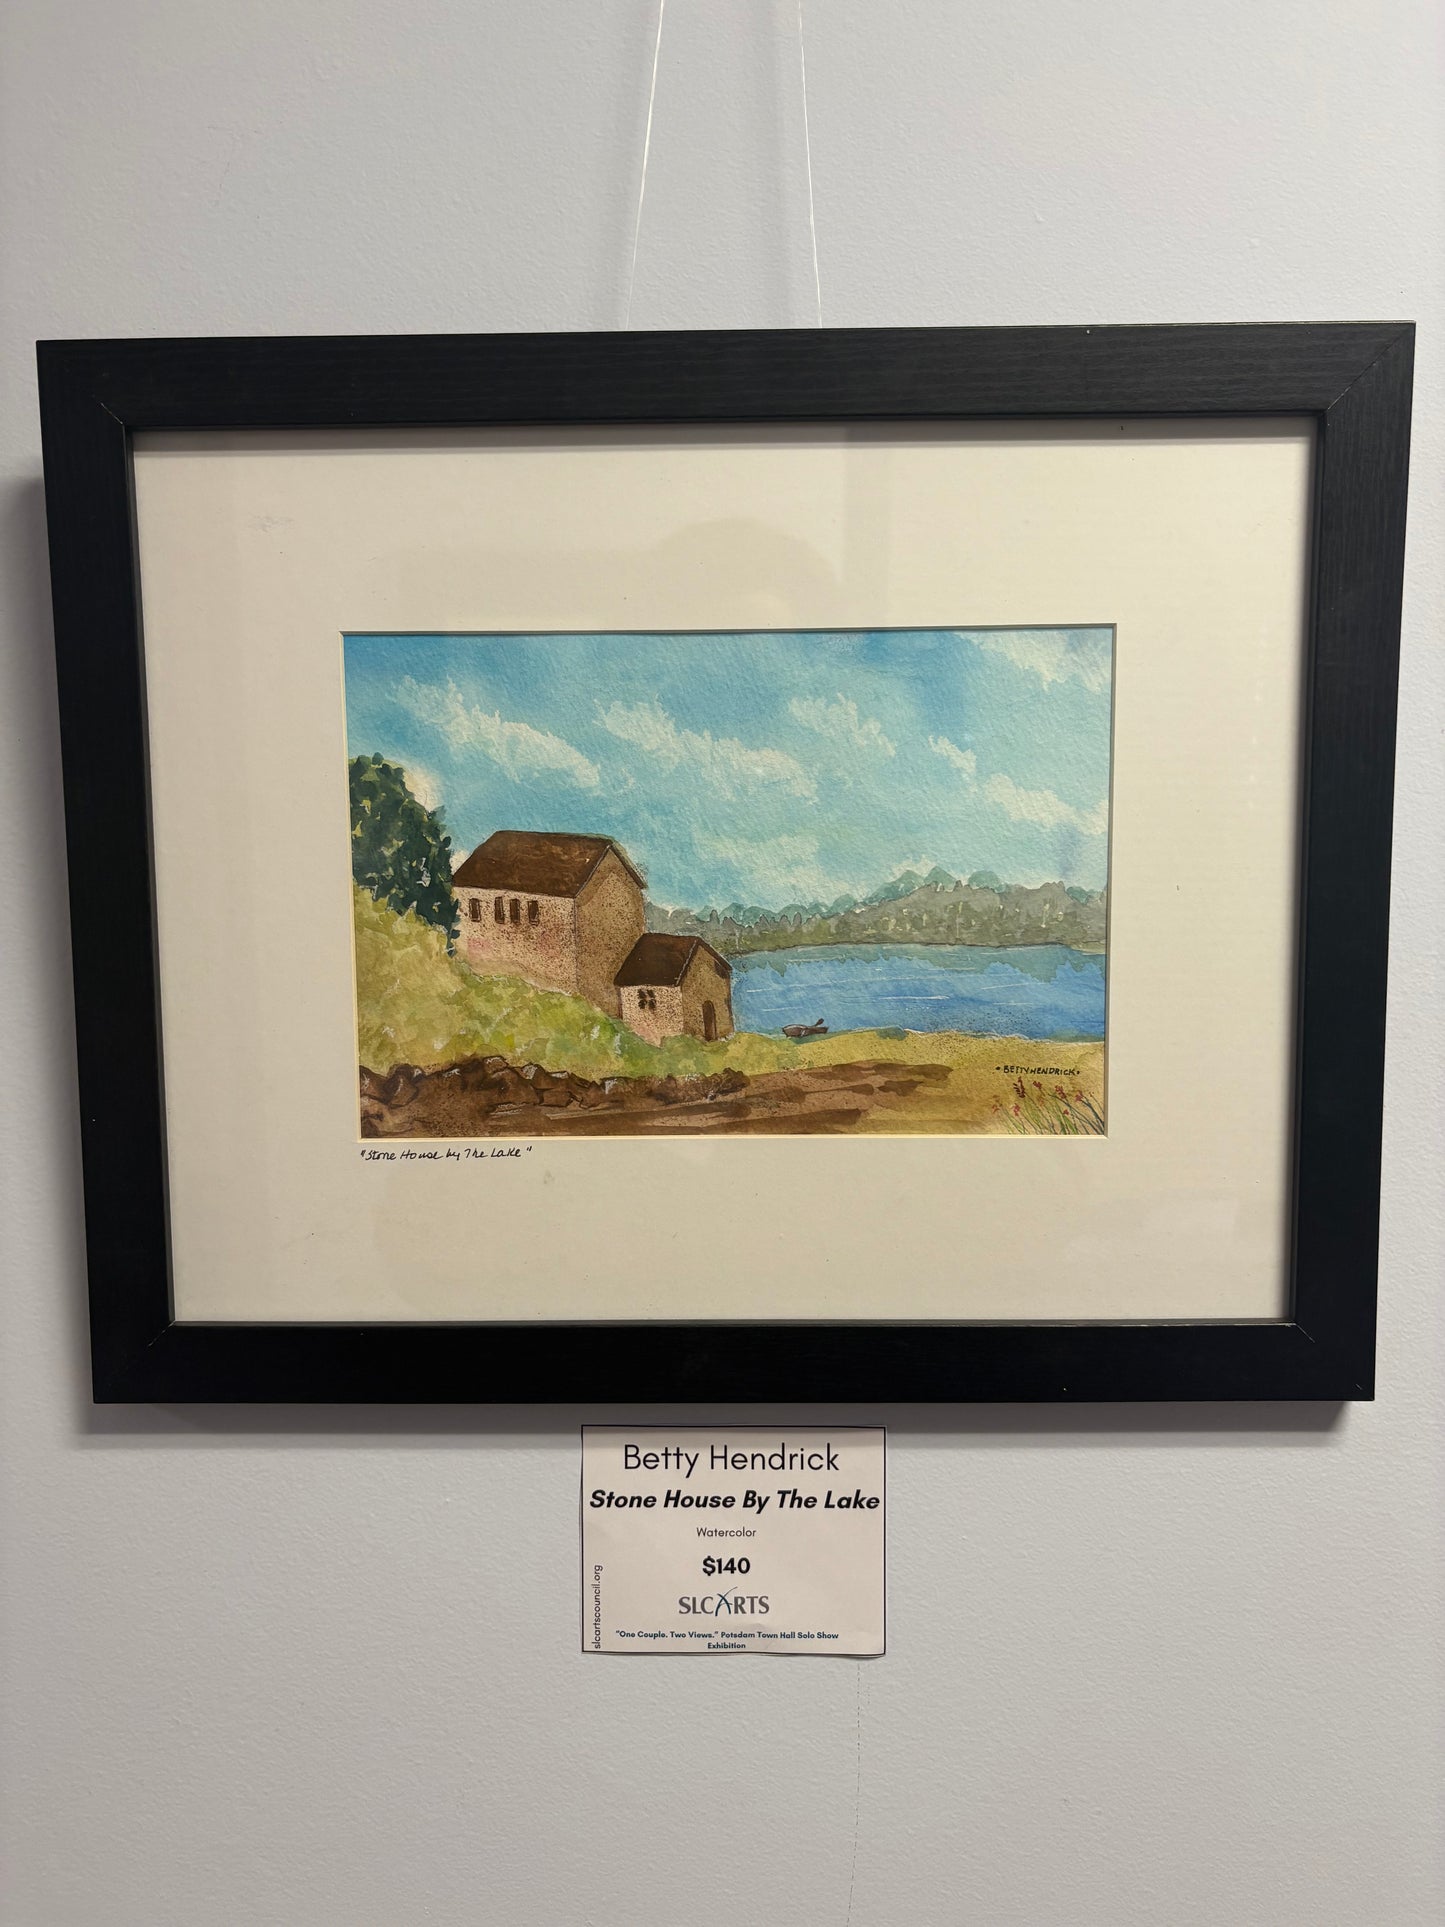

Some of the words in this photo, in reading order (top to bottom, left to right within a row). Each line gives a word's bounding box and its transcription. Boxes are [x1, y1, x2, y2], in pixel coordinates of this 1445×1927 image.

[399, 1149, 444, 1160] House
[445, 1148, 460, 1161] by
[464, 1148, 489, 1158] The
[623, 1443, 700, 1479] Betty
[709, 1442, 840, 1471] Hendrick
[589, 1488, 658, 1509] Stone
[663, 1489, 737, 1509] House
[742, 1489, 771, 1515] By
[776, 1488, 818, 1509] The
[823, 1488, 881, 1510] Lake
[695, 1526, 757, 1538] Watercolor
[701, 1555, 751, 1577] $140
[590, 1564, 604, 1650] slcartscouncil.org
[636, 1630, 669, 1641] Couple.
[669, 1630, 687, 1639] Two
[720, 1630, 756, 1639] Potsdam
[757, 1630, 778, 1640] Town
[779, 1630, 796, 1640] Hall
[797, 1630, 816, 1640] Solo
[816, 1630, 840, 1640] Show
[707, 1641, 747, 1650] Exhibition
